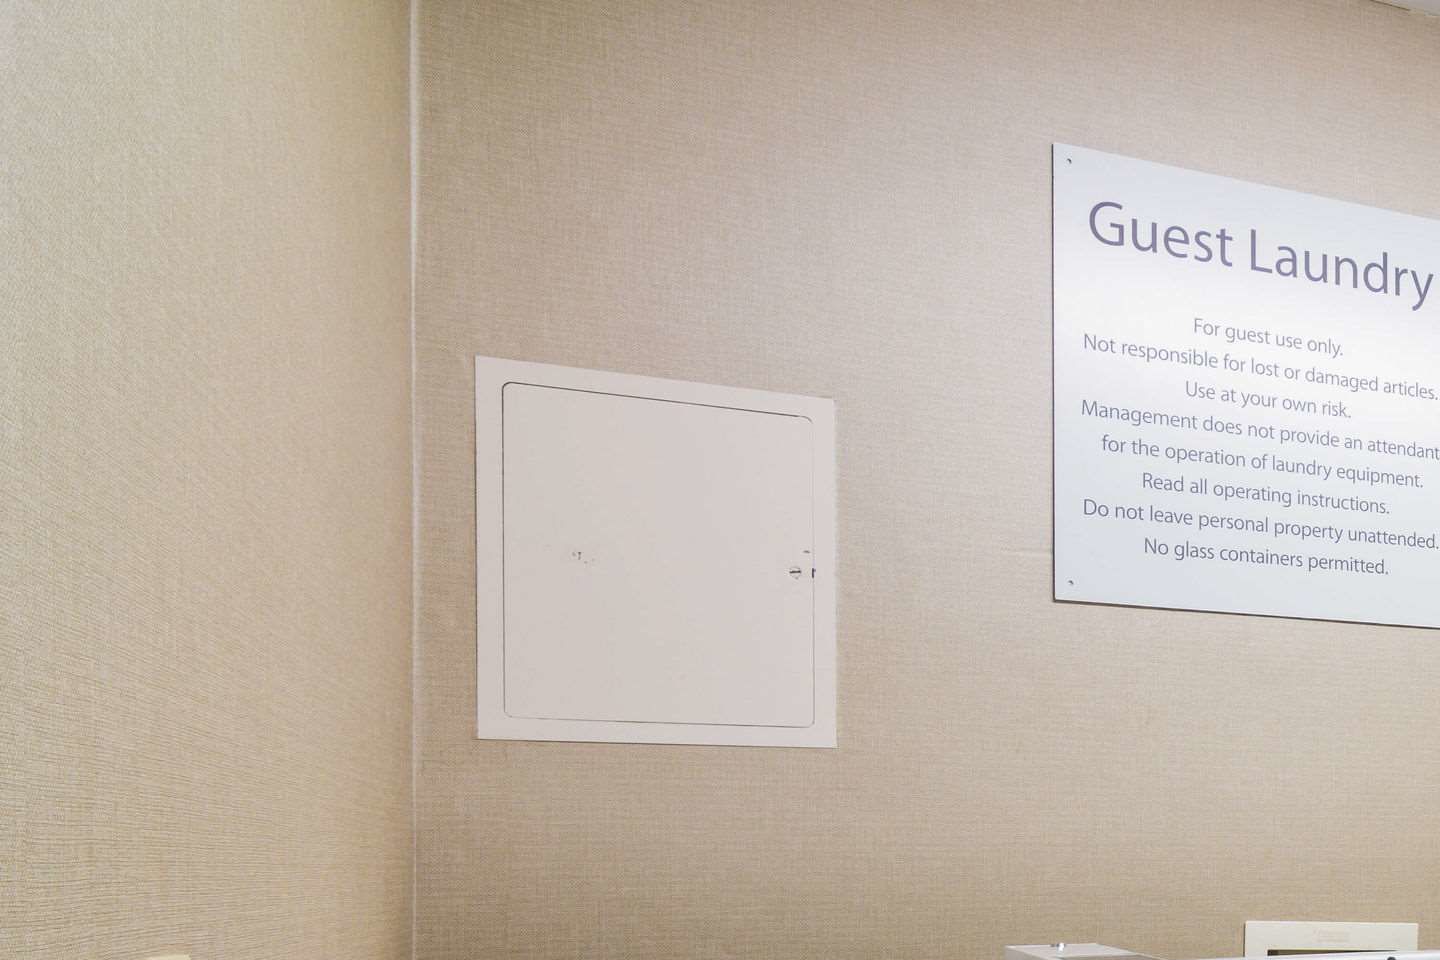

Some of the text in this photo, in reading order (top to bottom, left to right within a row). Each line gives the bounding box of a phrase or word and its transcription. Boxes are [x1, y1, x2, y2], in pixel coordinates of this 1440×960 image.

[1088, 200, 1434, 311] Guest Laundry
[1194, 317, 1343, 358] For guest use only.
[1084, 334, 1439, 400] Not responsible for lost or damaged articles.
[1186, 380, 1351, 418] Use at your own risk.
[1081, 400, 1440, 461] Management does not provide an attendant
[1102, 435, 1424, 488] for the operation of laundry equipment.
[1142, 472, 1390, 514] Read all operating instructions.
[1083, 499, 1439, 550] Do not leave personal property unattended.
[1144, 538, 1389, 575] No glass containers permitted.
